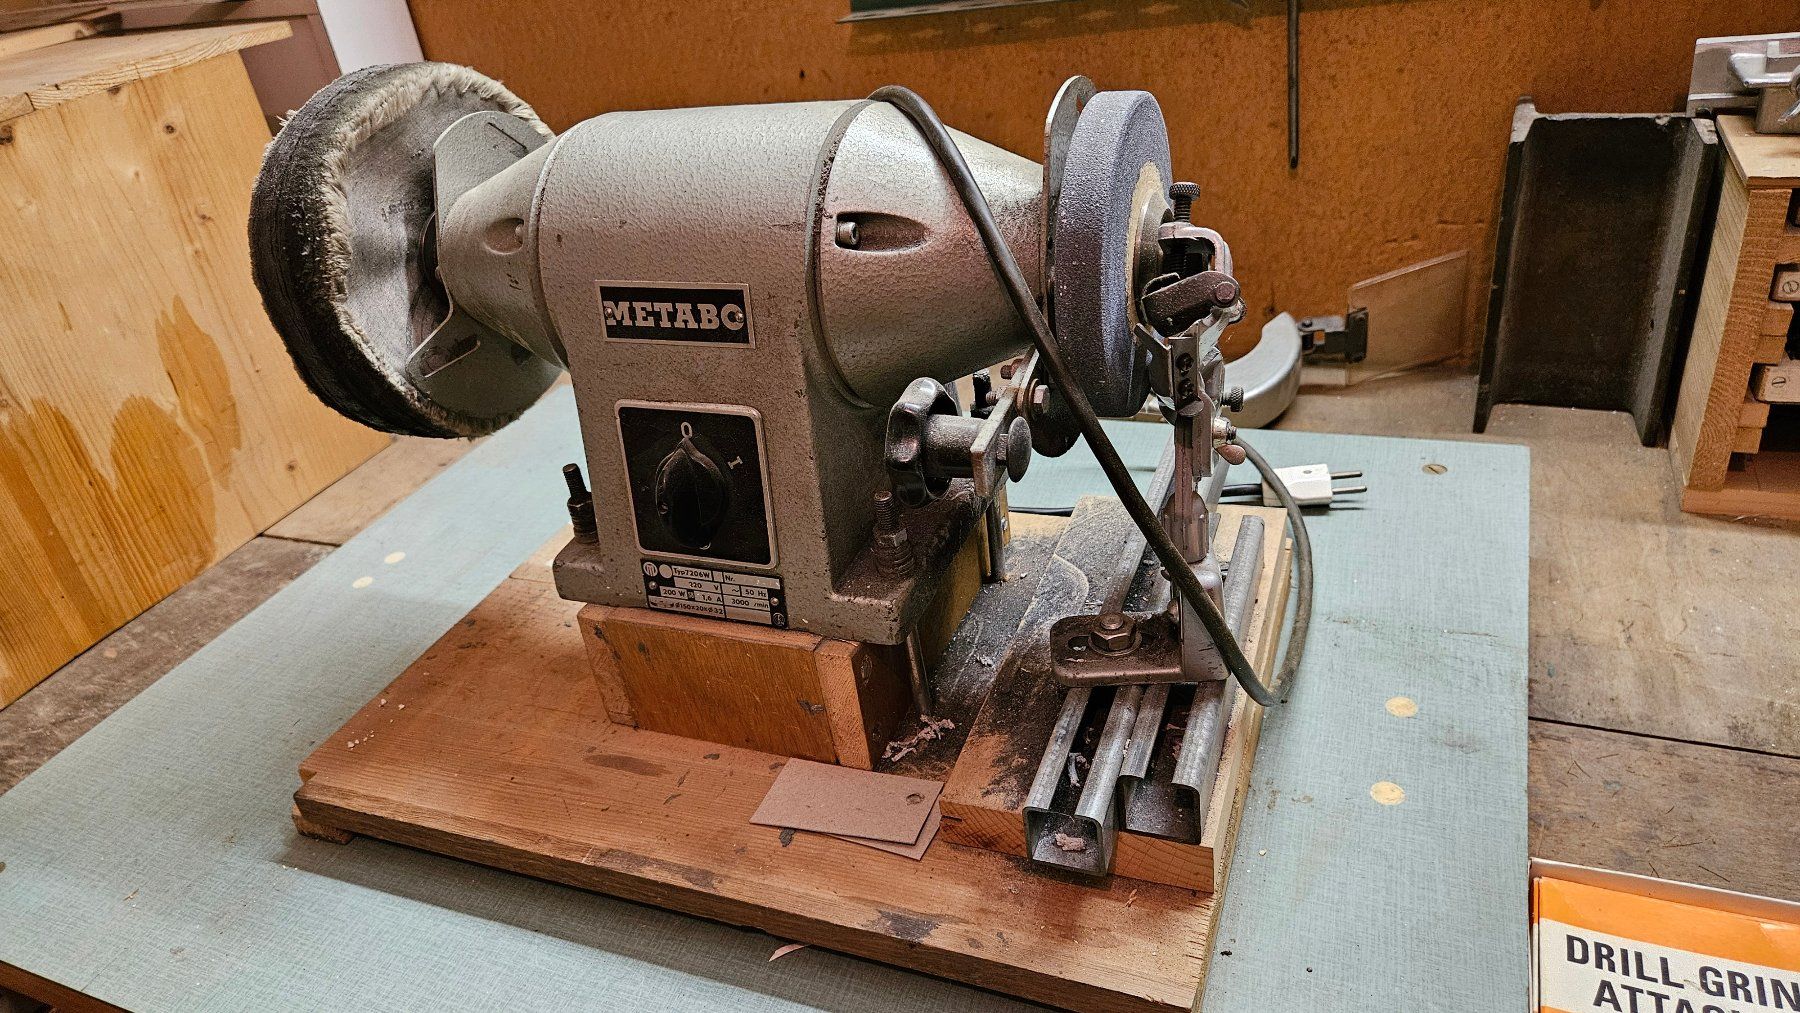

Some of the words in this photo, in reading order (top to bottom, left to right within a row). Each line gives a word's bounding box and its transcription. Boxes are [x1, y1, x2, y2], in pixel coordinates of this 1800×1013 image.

[603, 300, 745, 331] METABO
[688, 581, 702, 589] 220
[662, 588, 677, 596] 200
[745, 588, 755, 596] 50
[757, 590, 767, 598] Hz
[731, 598, 750, 606] 3000
[1566, 934, 1685, 990] DRILL
